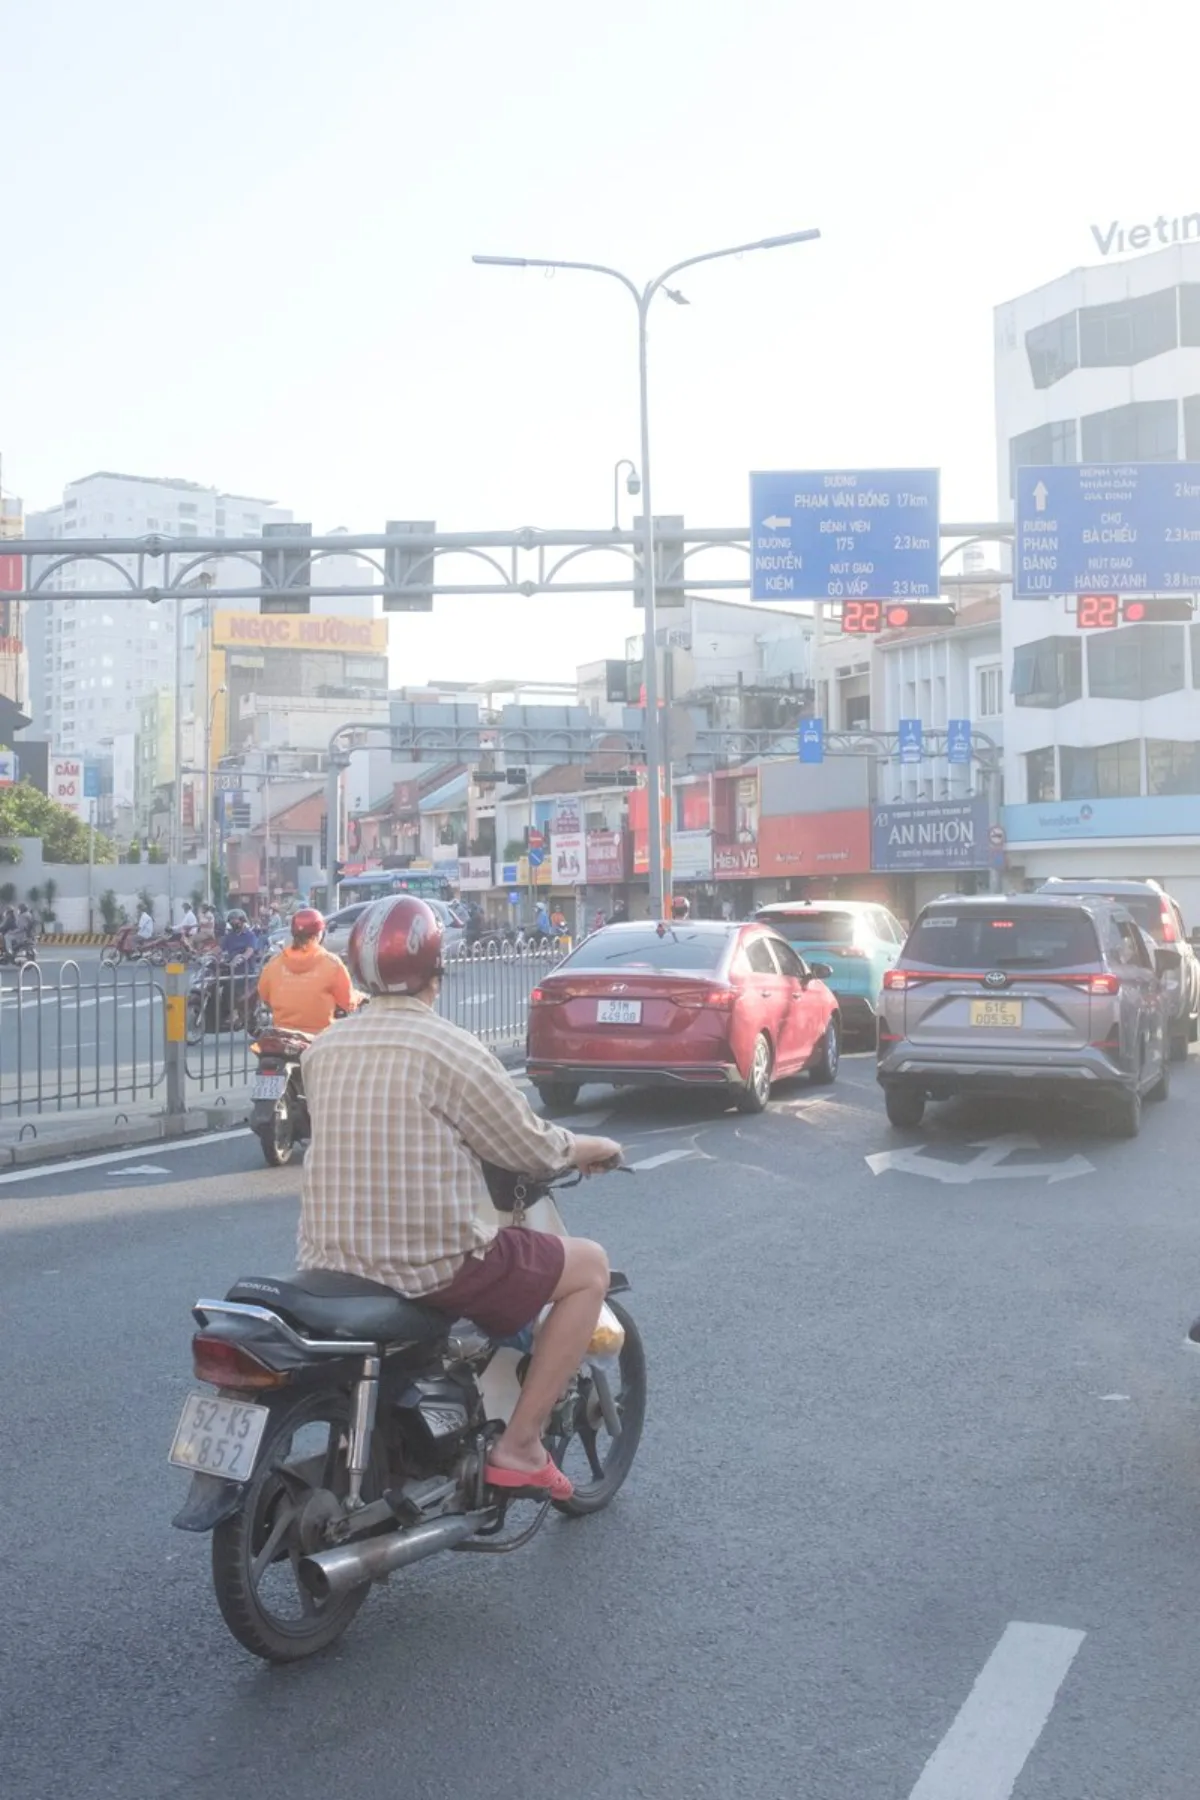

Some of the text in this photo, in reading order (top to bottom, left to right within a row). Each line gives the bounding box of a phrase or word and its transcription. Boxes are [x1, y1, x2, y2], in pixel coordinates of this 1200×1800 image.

[836, 537, 854, 551] 175
[912, 536, 930, 550] km
[1023, 536, 1059, 552] PHAN
[910, 580, 929, 595] km
[1112, 572, 1147, 588] XANH
[844, 602, 879, 630] 22
[1081, 597, 1117, 626] 22
[888, 823, 914, 845] AN
